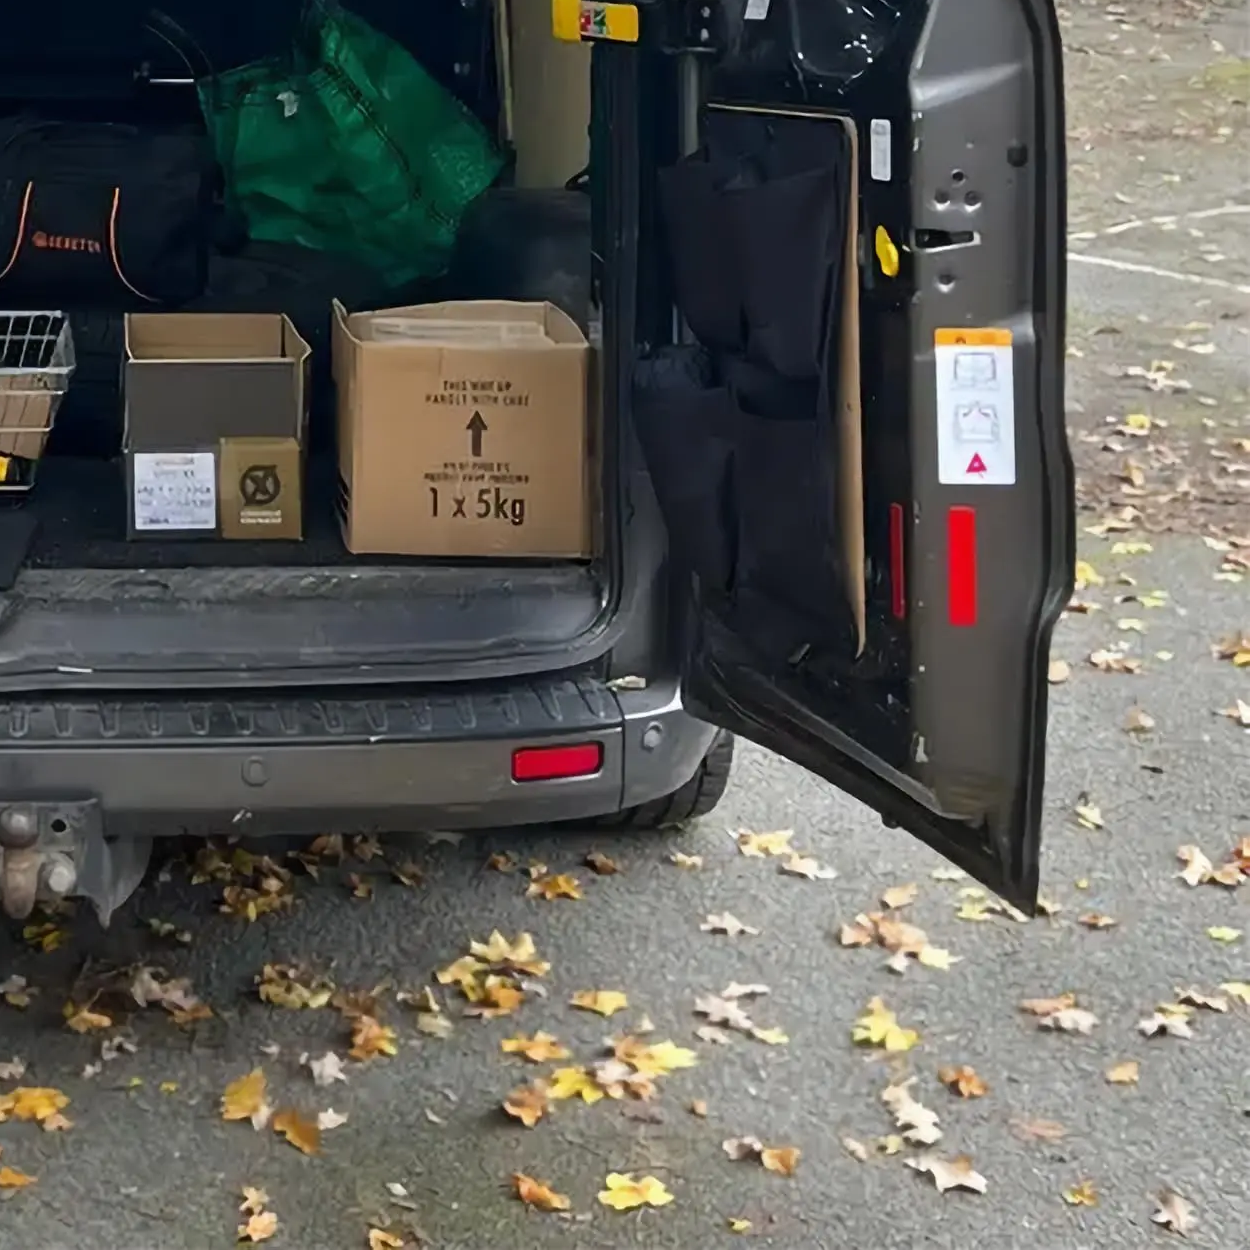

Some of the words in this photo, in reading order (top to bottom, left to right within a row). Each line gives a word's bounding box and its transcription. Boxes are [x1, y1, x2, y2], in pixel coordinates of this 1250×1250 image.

[430, 487, 438, 517] 1
[452, 496, 467, 518] x
[476, 487, 525, 526] 5kg
